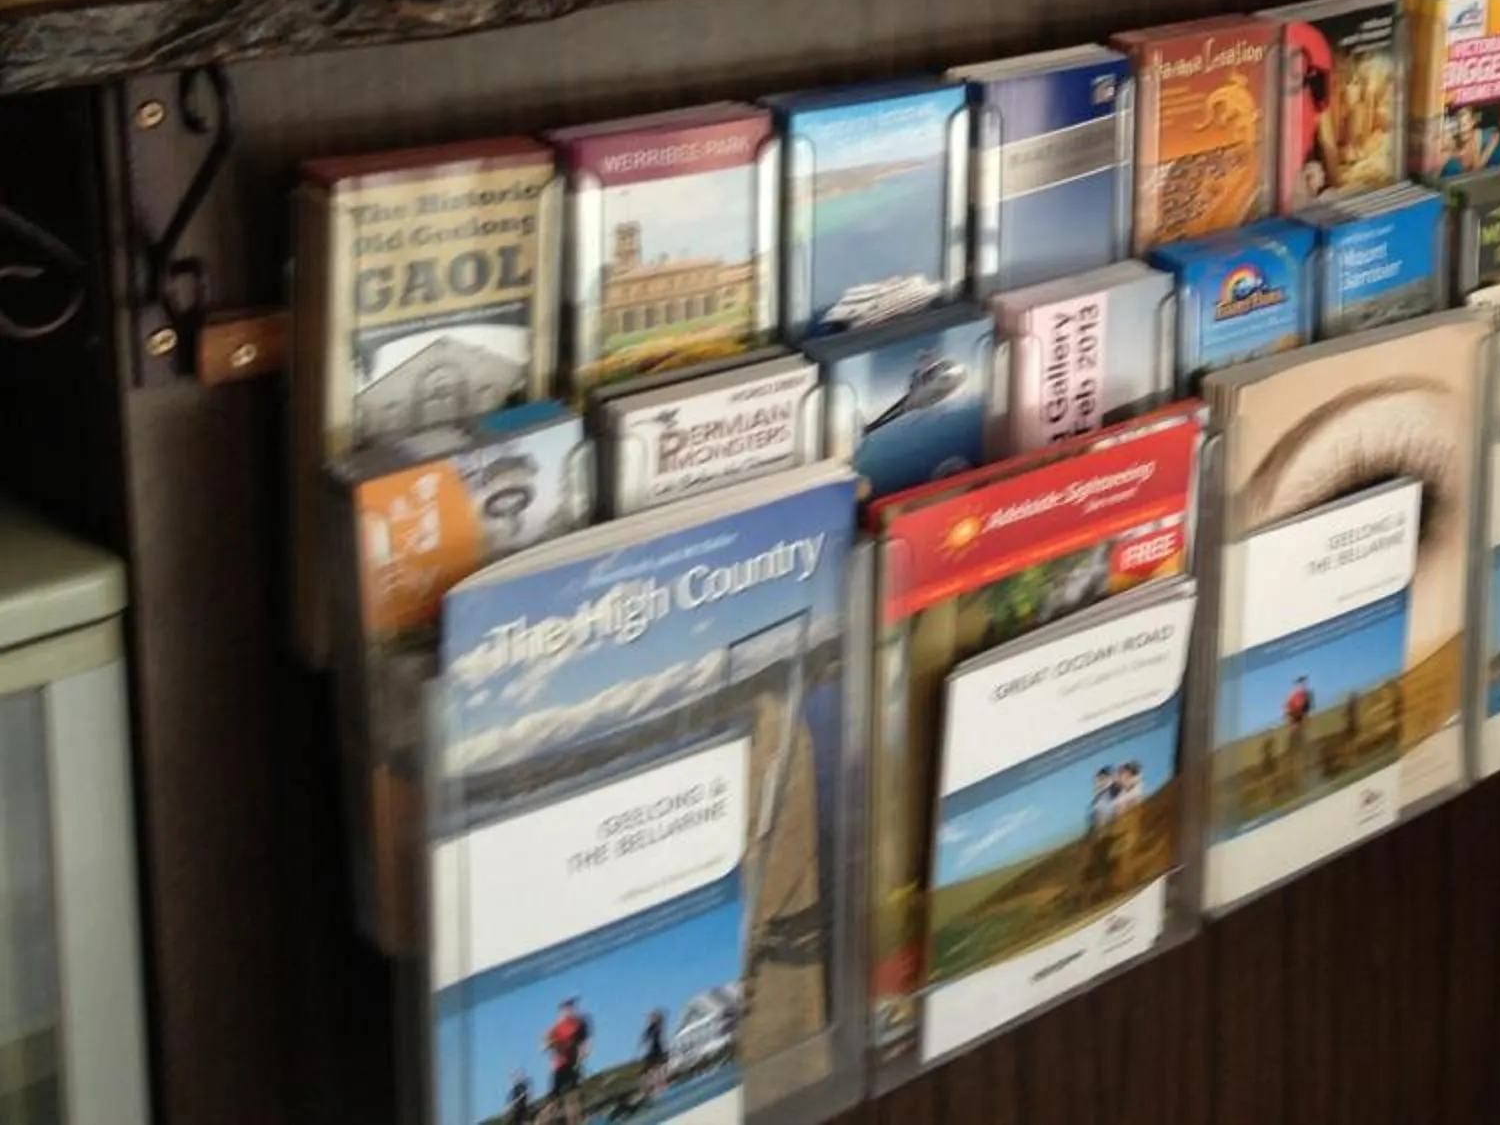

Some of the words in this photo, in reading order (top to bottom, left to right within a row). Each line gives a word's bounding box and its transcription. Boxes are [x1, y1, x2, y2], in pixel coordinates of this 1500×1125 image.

[704, 134, 751, 156] PARK
[350, 203, 406, 224] The
[417, 182, 542, 213] Historic
[409, 215, 535, 246] Geelong
[355, 244, 533, 316] GAOL
[1076, 303, 1100, 369] 2013
[1044, 312, 1075, 424] Gallery
[1075, 375, 1099, 435] Feb
[659, 400, 793, 474] PERMIAN
[667, 424, 792, 472] MONSTERS
[1120, 531, 1178, 572] FREE
[488, 616, 571, 665] The
[577, 577, 671, 645] High
[674, 533, 826, 611] Country
[1121, 626, 1175, 653] ROAD
[565, 842, 610, 876] THE
